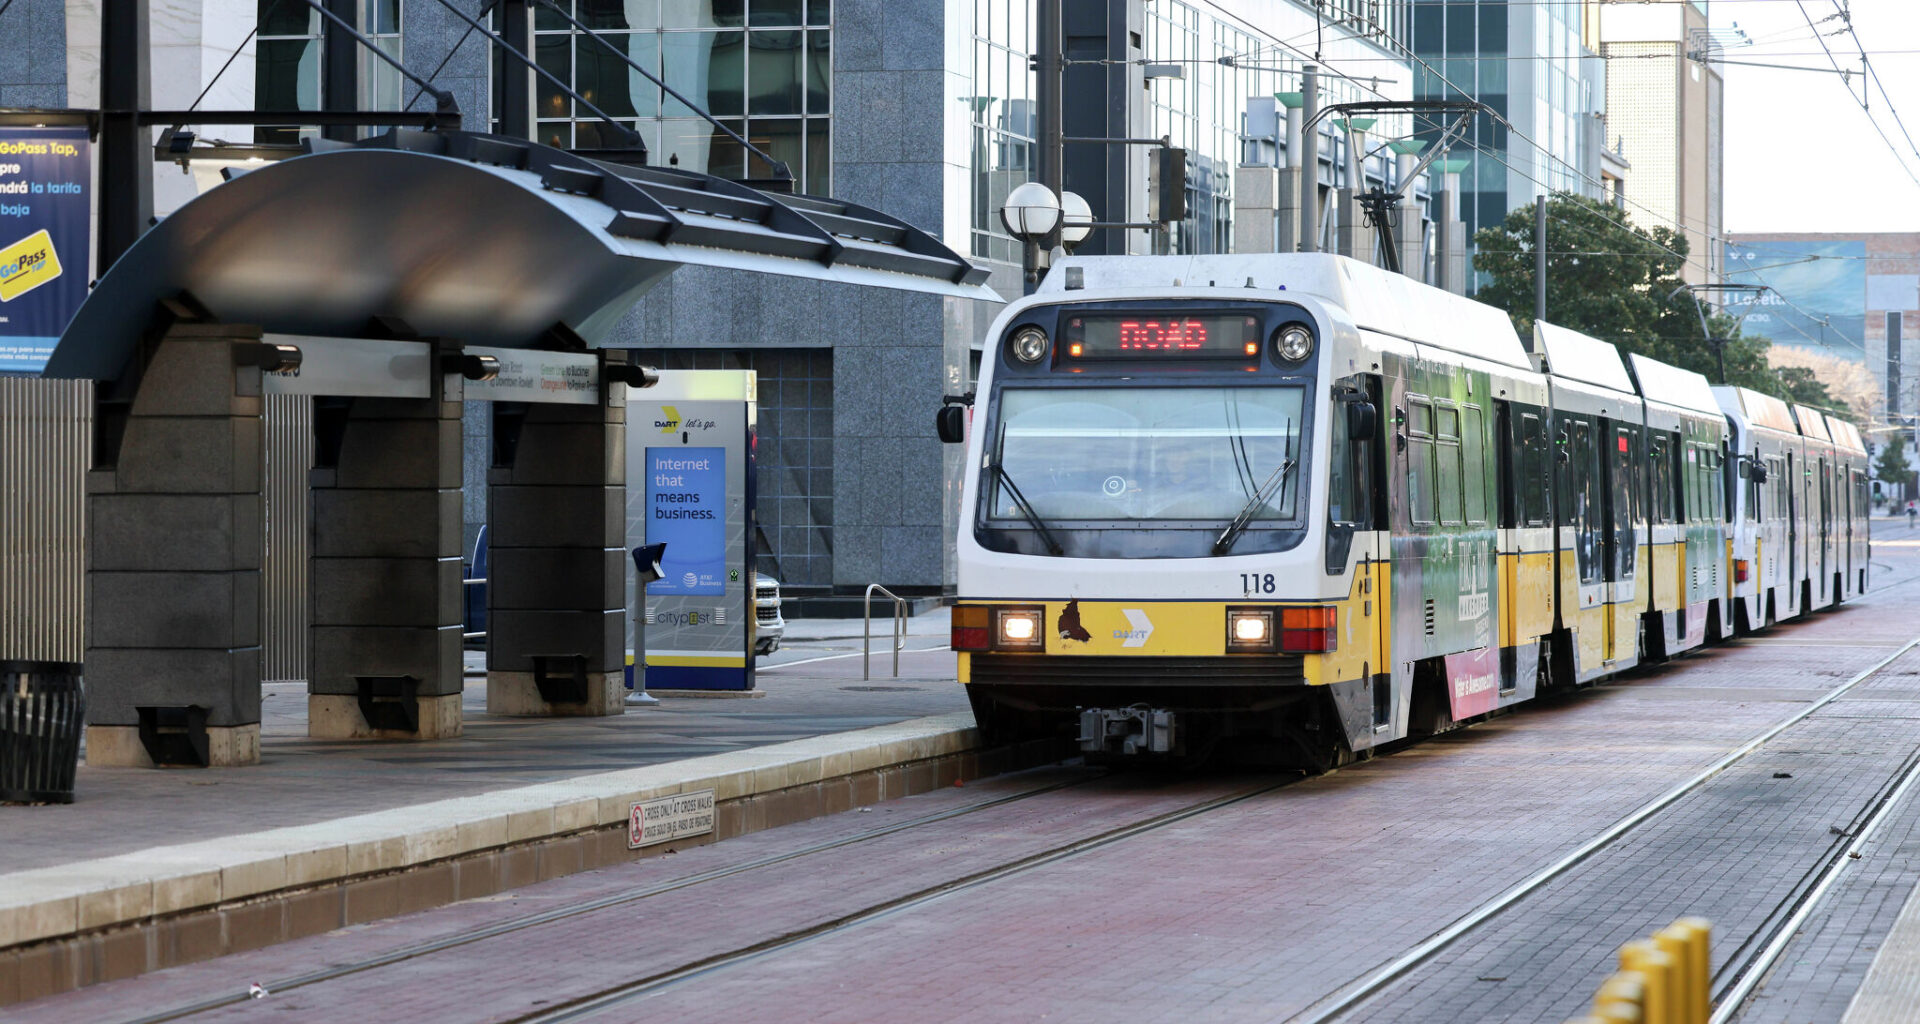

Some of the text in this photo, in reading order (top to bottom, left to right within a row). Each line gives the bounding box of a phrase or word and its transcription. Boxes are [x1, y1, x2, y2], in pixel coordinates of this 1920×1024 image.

[0, 142, 78, 157] GoPass Tap,
[31, 182, 43, 193] la
[47, 182, 81, 194] tarifa
[1, 204, 30, 218] baja
[0, 249, 46, 278] GoPass
[1121, 322, 1206, 349] ROAD
[685, 418, 702, 428] let's
[703, 421, 717, 431] go.
[655, 458, 710, 470] Internet
[655, 474, 683, 487] that
[655, 493, 700, 503] means
[655, 507, 716, 520] business.
[1240, 573, 1276, 594] 118
[1113, 630, 1148, 639] DART
[645, 796, 712, 820] CROSS ONLY AT CROSS WALKS
